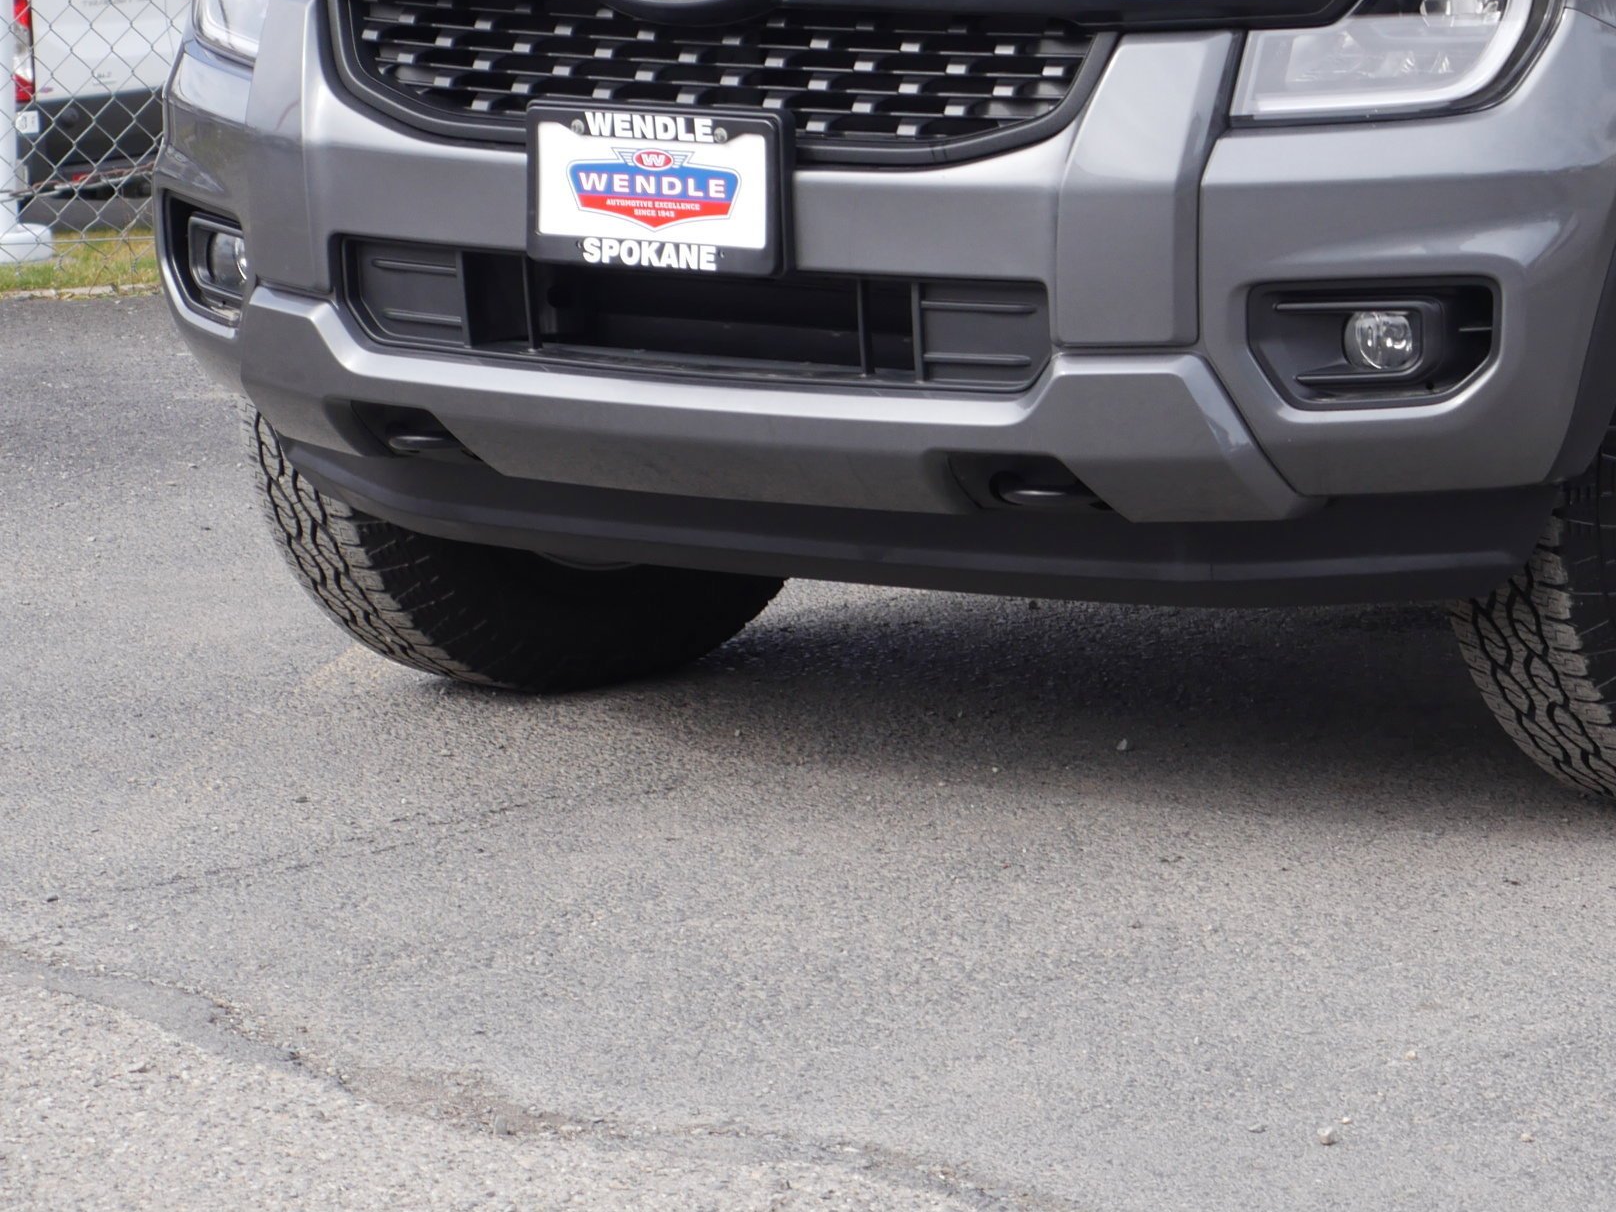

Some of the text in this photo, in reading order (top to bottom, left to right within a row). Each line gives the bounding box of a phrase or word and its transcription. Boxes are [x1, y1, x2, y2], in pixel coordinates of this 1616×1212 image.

[584, 111, 715, 143] WENDLE
[579, 172, 726, 199] WENDLE
[605, 198, 701, 211] AUTOMOTIVE EXCELLENCE
[633, 208, 675, 218] SINCE 1943
[582, 237, 717, 271] SPOKANE
